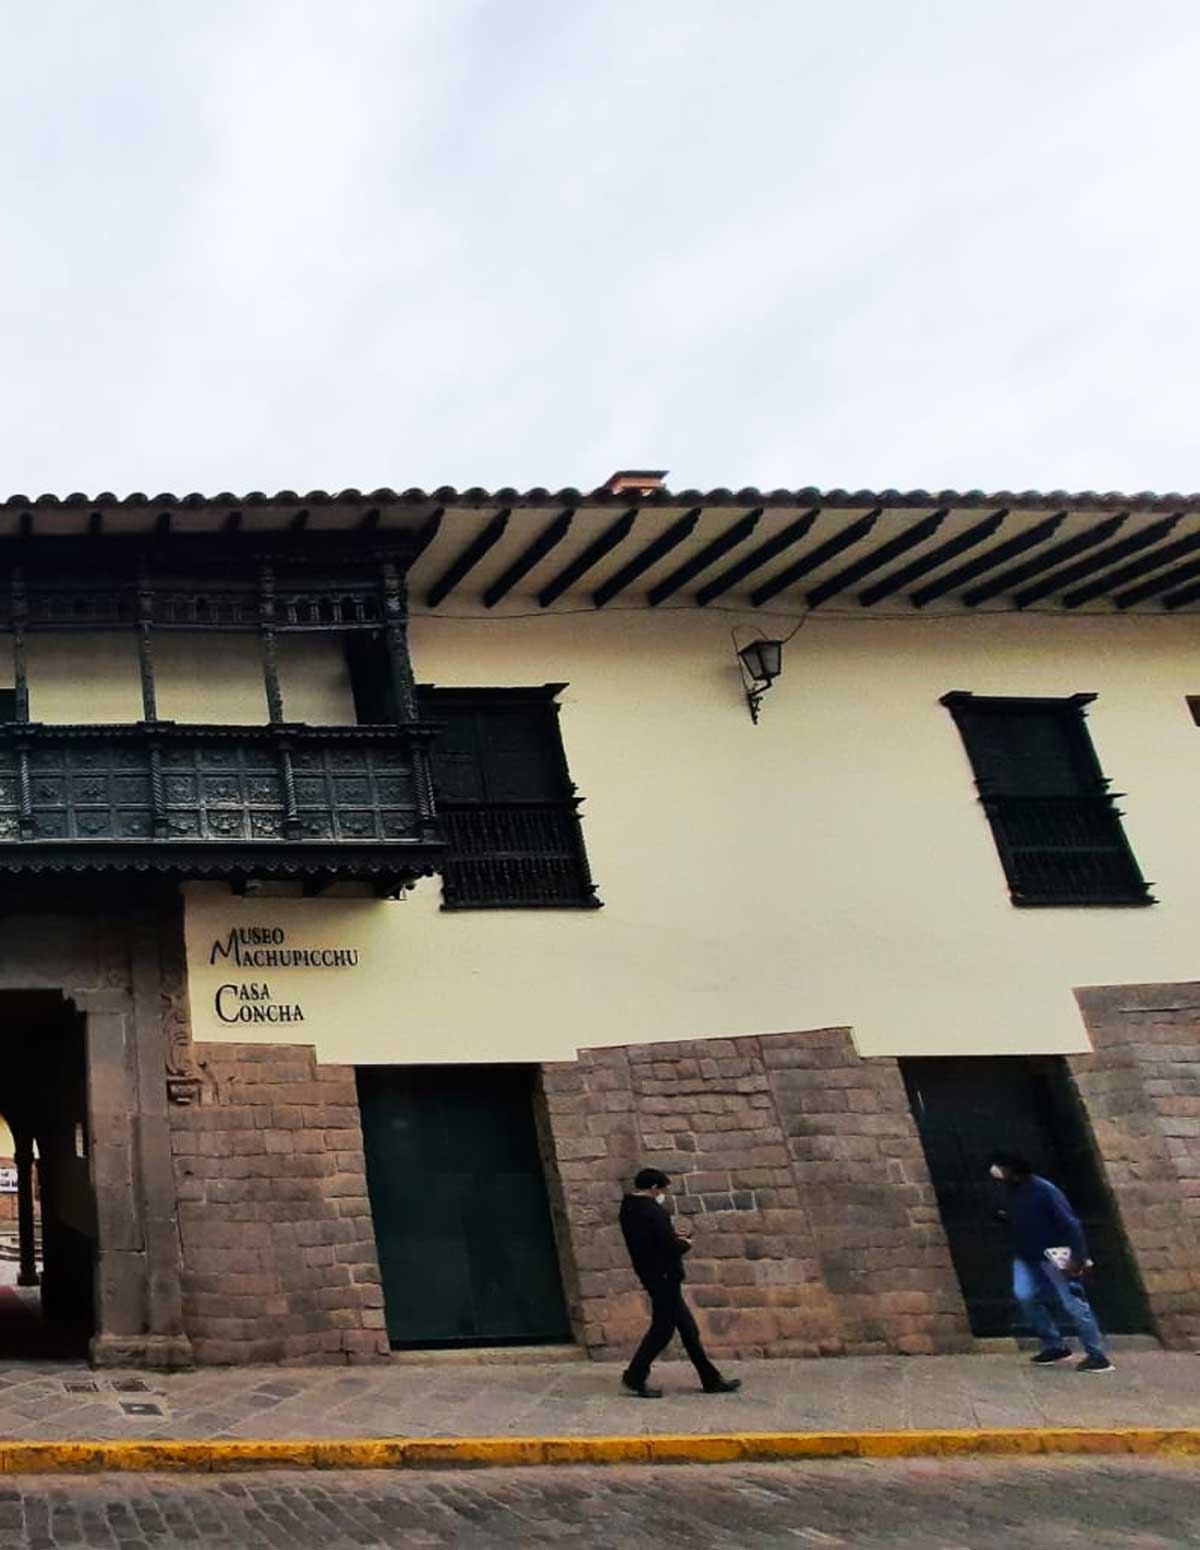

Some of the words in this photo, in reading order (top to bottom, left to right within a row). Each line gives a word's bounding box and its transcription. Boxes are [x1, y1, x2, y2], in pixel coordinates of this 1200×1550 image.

[210, 927, 285, 967] MUSEO
[215, 983, 271, 1023] CASA
[215, 984, 305, 1023] CONCHA
